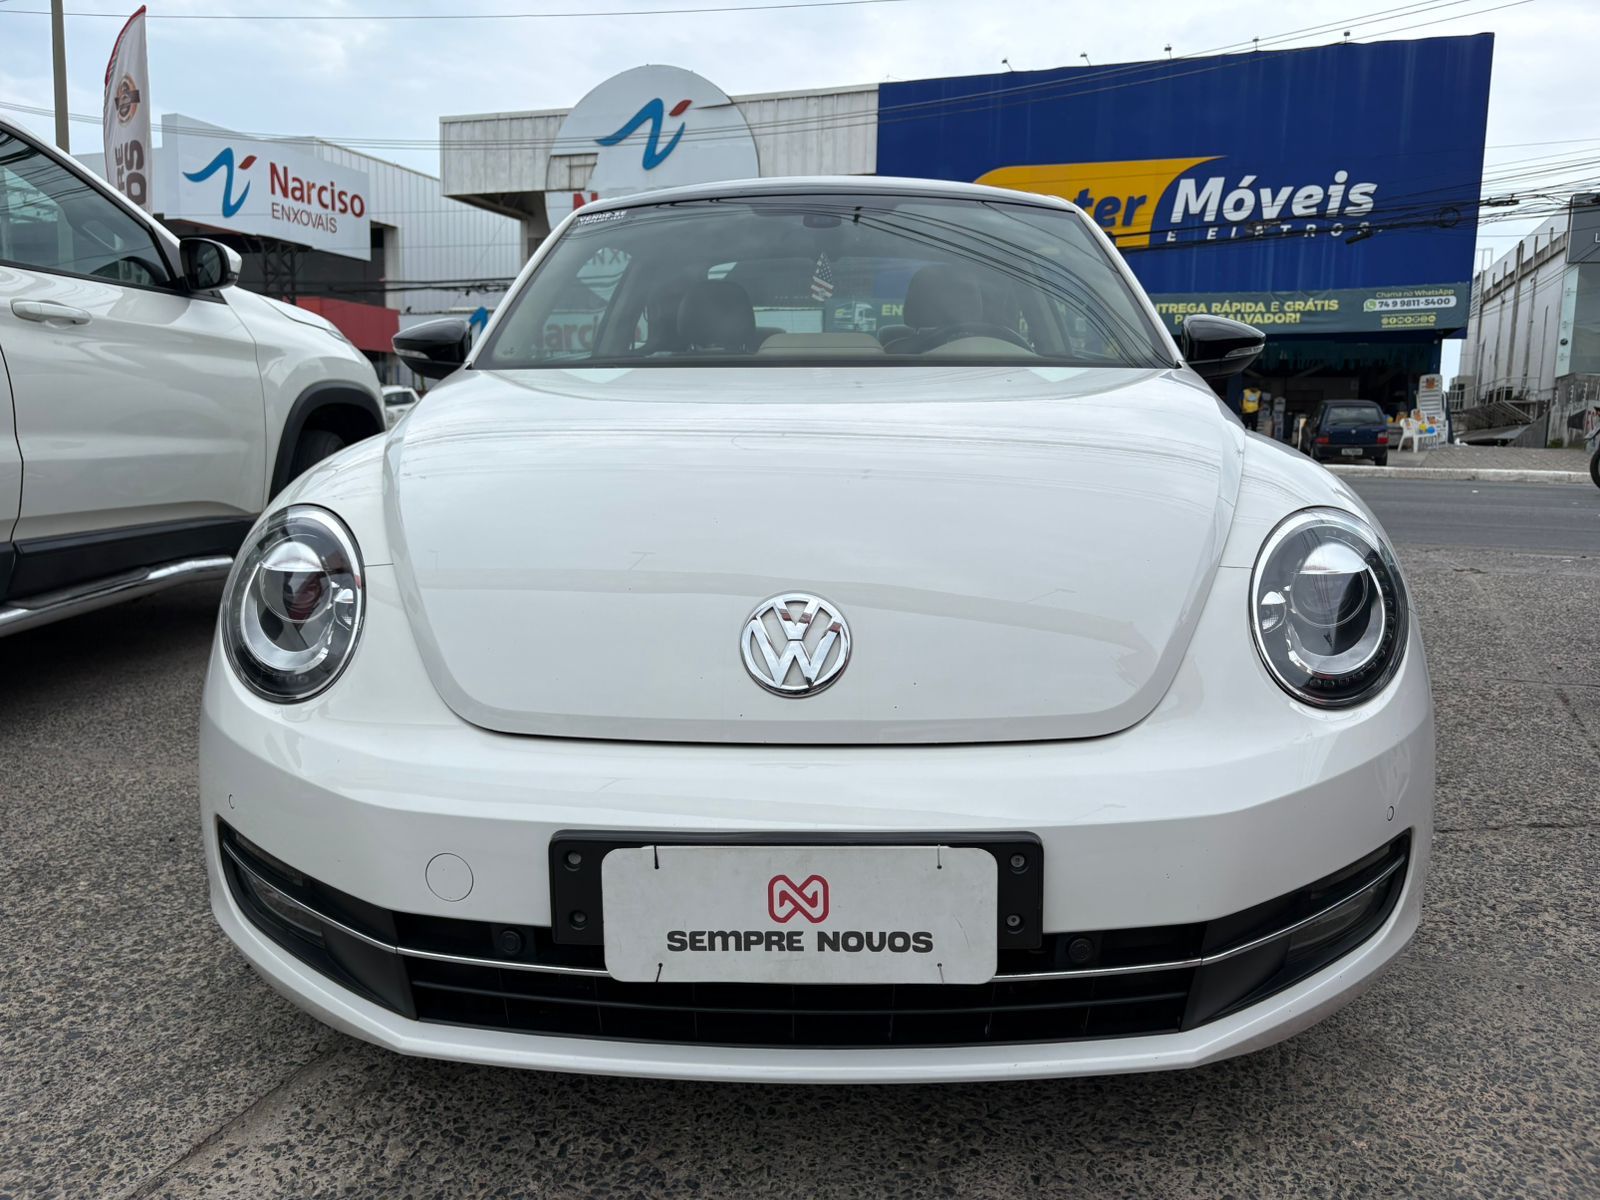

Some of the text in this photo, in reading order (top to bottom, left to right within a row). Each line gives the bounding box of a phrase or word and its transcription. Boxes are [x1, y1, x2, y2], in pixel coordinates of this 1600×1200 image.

[270, 162, 365, 218] Narciso
[1170, 170, 1378, 223] Móveis
[271, 202, 338, 234] ENXOVAIS
[1378, 297, 1451, 308] 74 9 9811-5400
[1414, 288, 1455, 297] WhatsApp
[1211, 300, 1266, 314] RÁPIDA
[1271, 301, 1280, 312] E
[1284, 298, 1339, 312] GRÁTIS
[666, 930, 934, 953] SEMPRE NOVOS
